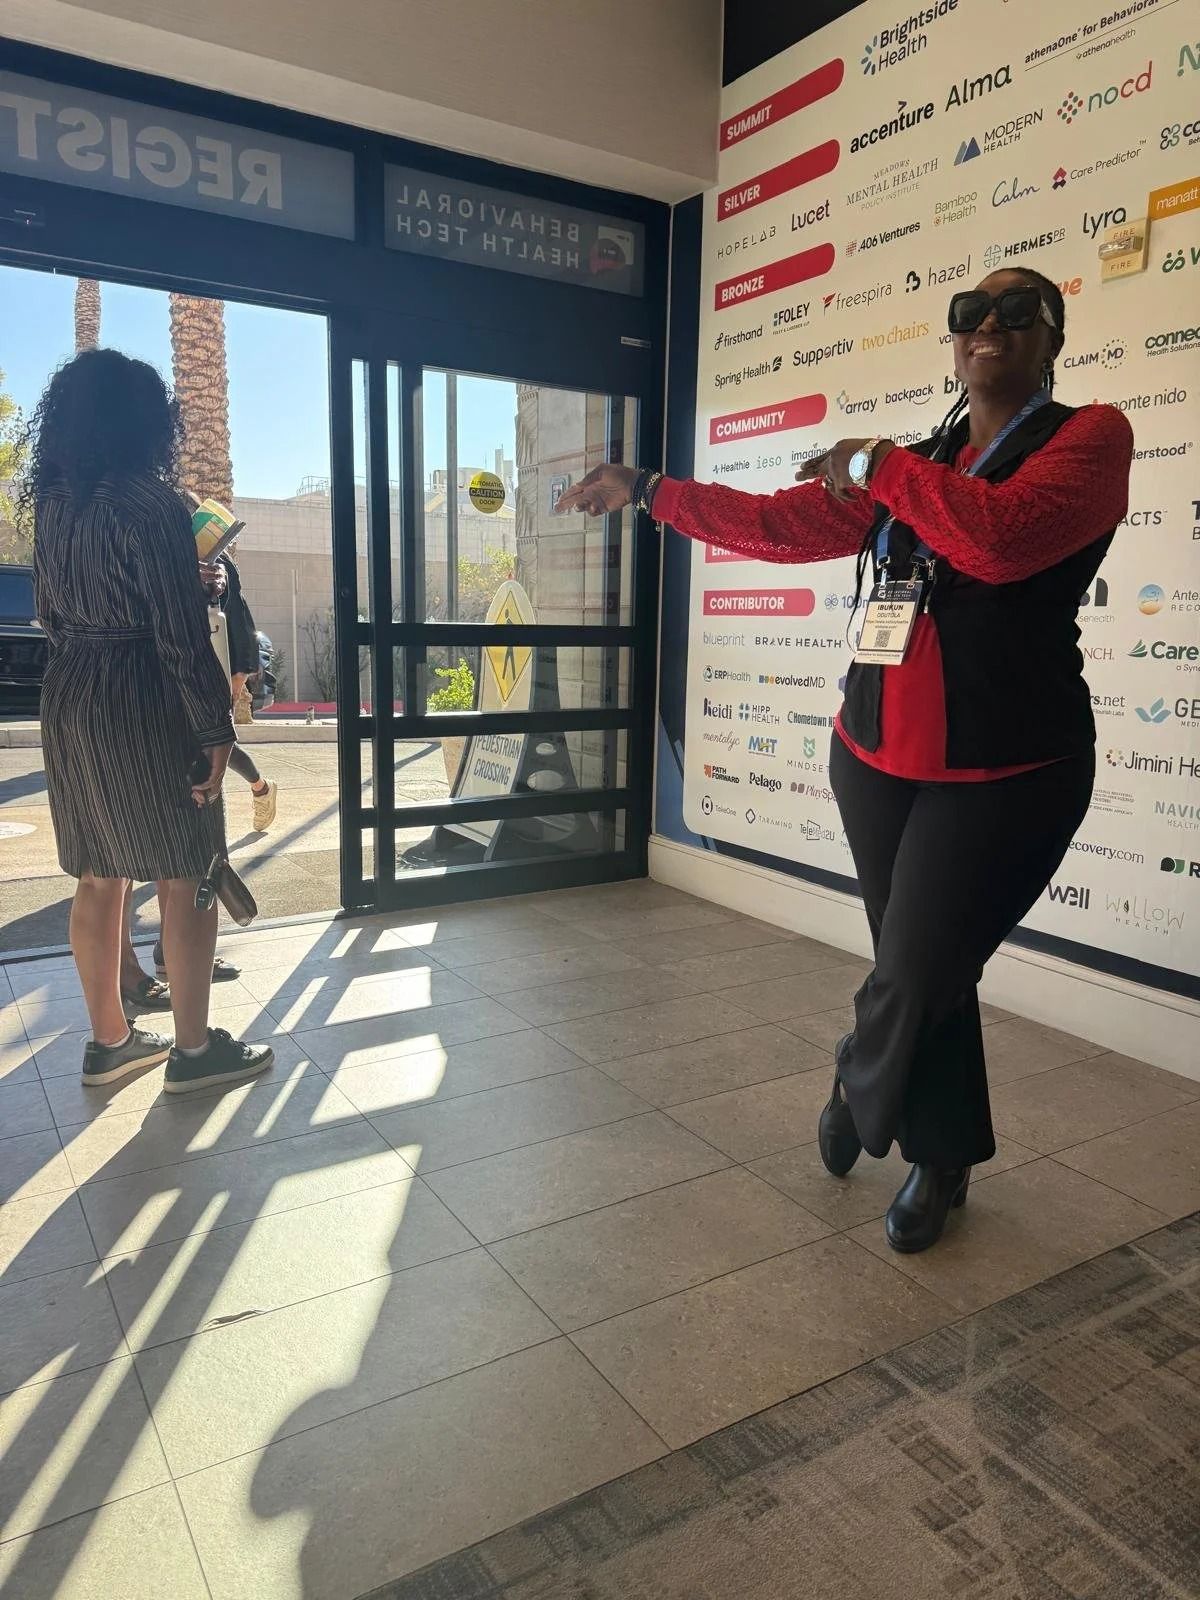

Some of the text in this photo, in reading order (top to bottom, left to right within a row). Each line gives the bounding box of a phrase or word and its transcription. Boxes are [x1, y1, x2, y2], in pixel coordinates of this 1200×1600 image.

[880, 0, 959, 49] Brightside
[1082, 21, 1098, 38] for
[1100, 0, 1159, 29] Behaviora
[878, 33, 927, 71] Health
[1082, 28, 1136, 58] athenahealth
[945, 64, 1013, 112] Alma
[1088, 60, 1153, 112] nocd
[727, 104, 773, 141] SUMMIT
[850, 101, 935, 153] accenture
[984, 108, 1044, 144] MODERN
[983, 132, 1022, 154] HEALTH
[873, 158, 910, 180] MEADOWS
[1070, 163, 1094, 180] Care
[846, 157, 939, 206] MENTAL HEALTH
[886, 182, 921, 202] INSTITUTE
[991, 177, 1041, 208] Calm
[724, 184, 761, 212] SILVER
[934, 191, 978, 215] Bamboo
[1157, 186, 1199, 210] manatt
[791, 199, 831, 232] Lucet
[943, 205, 977, 225] Health
[1082, 207, 1127, 239] lyra
[717, 225, 777, 259] HOPELAB
[880, 221, 921, 244] Ventures
[1113, 227, 1136, 240] FIRE
[927, 254, 972, 287] hazel
[1110, 261, 1132, 271] FIRE
[721, 275, 765, 303] BRONZE
[836, 282, 893, 311] freespira
[778, 300, 811, 326] FOLEY
[723, 325, 763, 349] firsthand
[862, 321, 929, 351] two chairs
[793, 338, 854, 368] Supportiv
[1064, 347, 1124, 369] CLAIM MD
[715, 362, 771, 388] Spring Health
[846, 396, 878, 415] array
[885, 383, 934, 404] backpack
[1154, 387, 1187, 407] nido
[716, 411, 786, 438] COMMUNITY
[720, 459, 750, 473] Healthie
[756, 456, 782, 469] ieso
[470, 488, 504, 498] CAUTION
[709, 597, 785, 610] CONTRIBUTOR
[703, 631, 745, 647] blueprint
[755, 636, 842, 649] BRAVE HEALTH
[714, 669, 751, 683] ERPHealth
[774, 674, 826, 689] evolvedMD
[751, 714, 780, 725] HEALTH
[752, 704, 771, 714] HIPP
[476, 735, 522, 760] PEDESTRIAN
[703, 730, 740, 751] mentalyc
[473, 758, 511, 785] CROSSING
[712, 765, 727, 775] PATH
[1124, 750, 1174, 775] Jimini
[712, 773, 740, 784] FORWARD
[750, 772, 782, 792] Pelago
[1115, 917, 1169, 936] HEALTH
